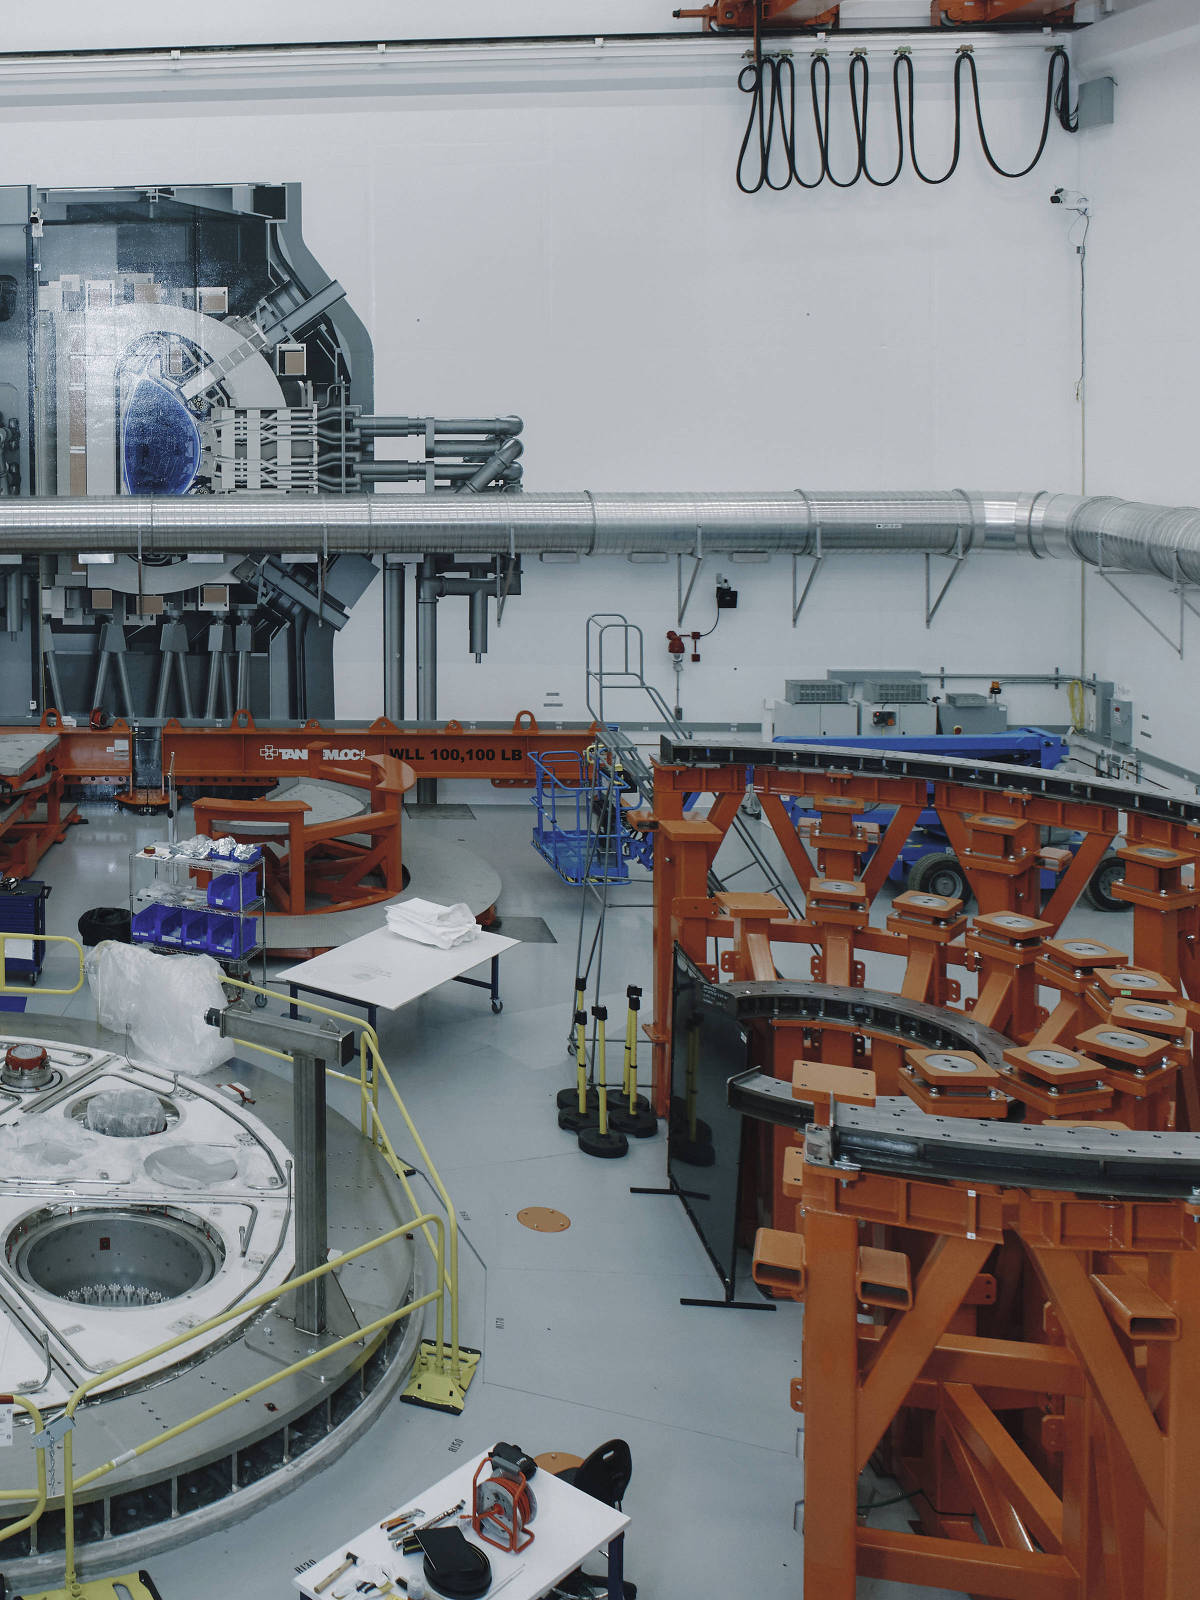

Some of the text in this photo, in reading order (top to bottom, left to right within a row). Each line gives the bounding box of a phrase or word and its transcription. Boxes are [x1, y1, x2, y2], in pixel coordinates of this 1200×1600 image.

[389, 748, 523, 763] WLL 100,100 LB
